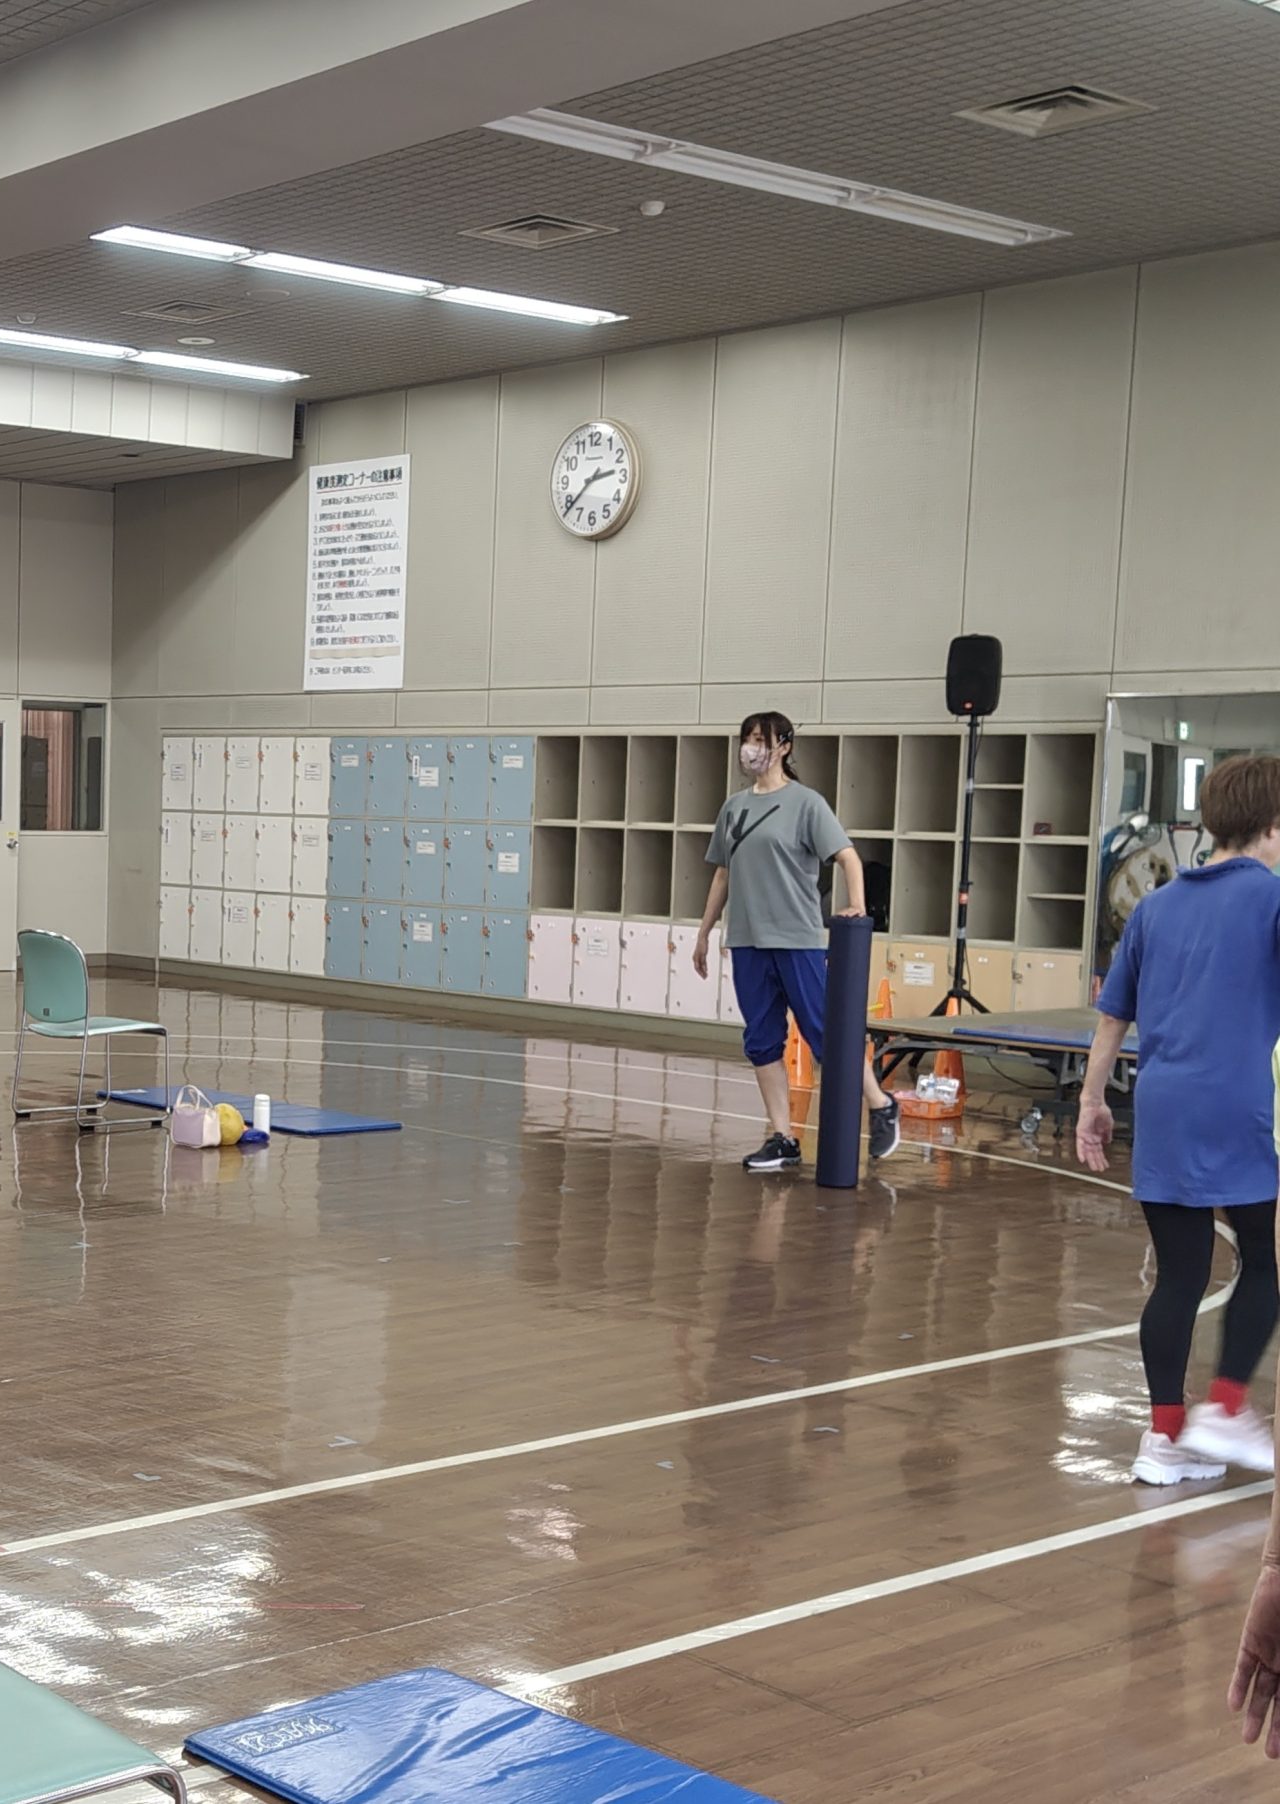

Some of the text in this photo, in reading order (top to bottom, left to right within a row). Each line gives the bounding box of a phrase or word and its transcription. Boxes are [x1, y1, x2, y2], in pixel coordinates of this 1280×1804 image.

[588, 431, 602, 447] 12
[607, 436, 613, 451] 1
[575, 439, 586, 455] 11
[615, 448, 624, 463] 2
[565, 456, 578, 471] 10
[561, 475, 569, 491] 9
[619, 468, 628, 484] 3
[565, 494, 573, 511] 8
[613, 489, 621, 504] 4
[576, 507, 584, 522] 7
[587, 511, 596, 526] 6
[602, 504, 611, 519] 5
